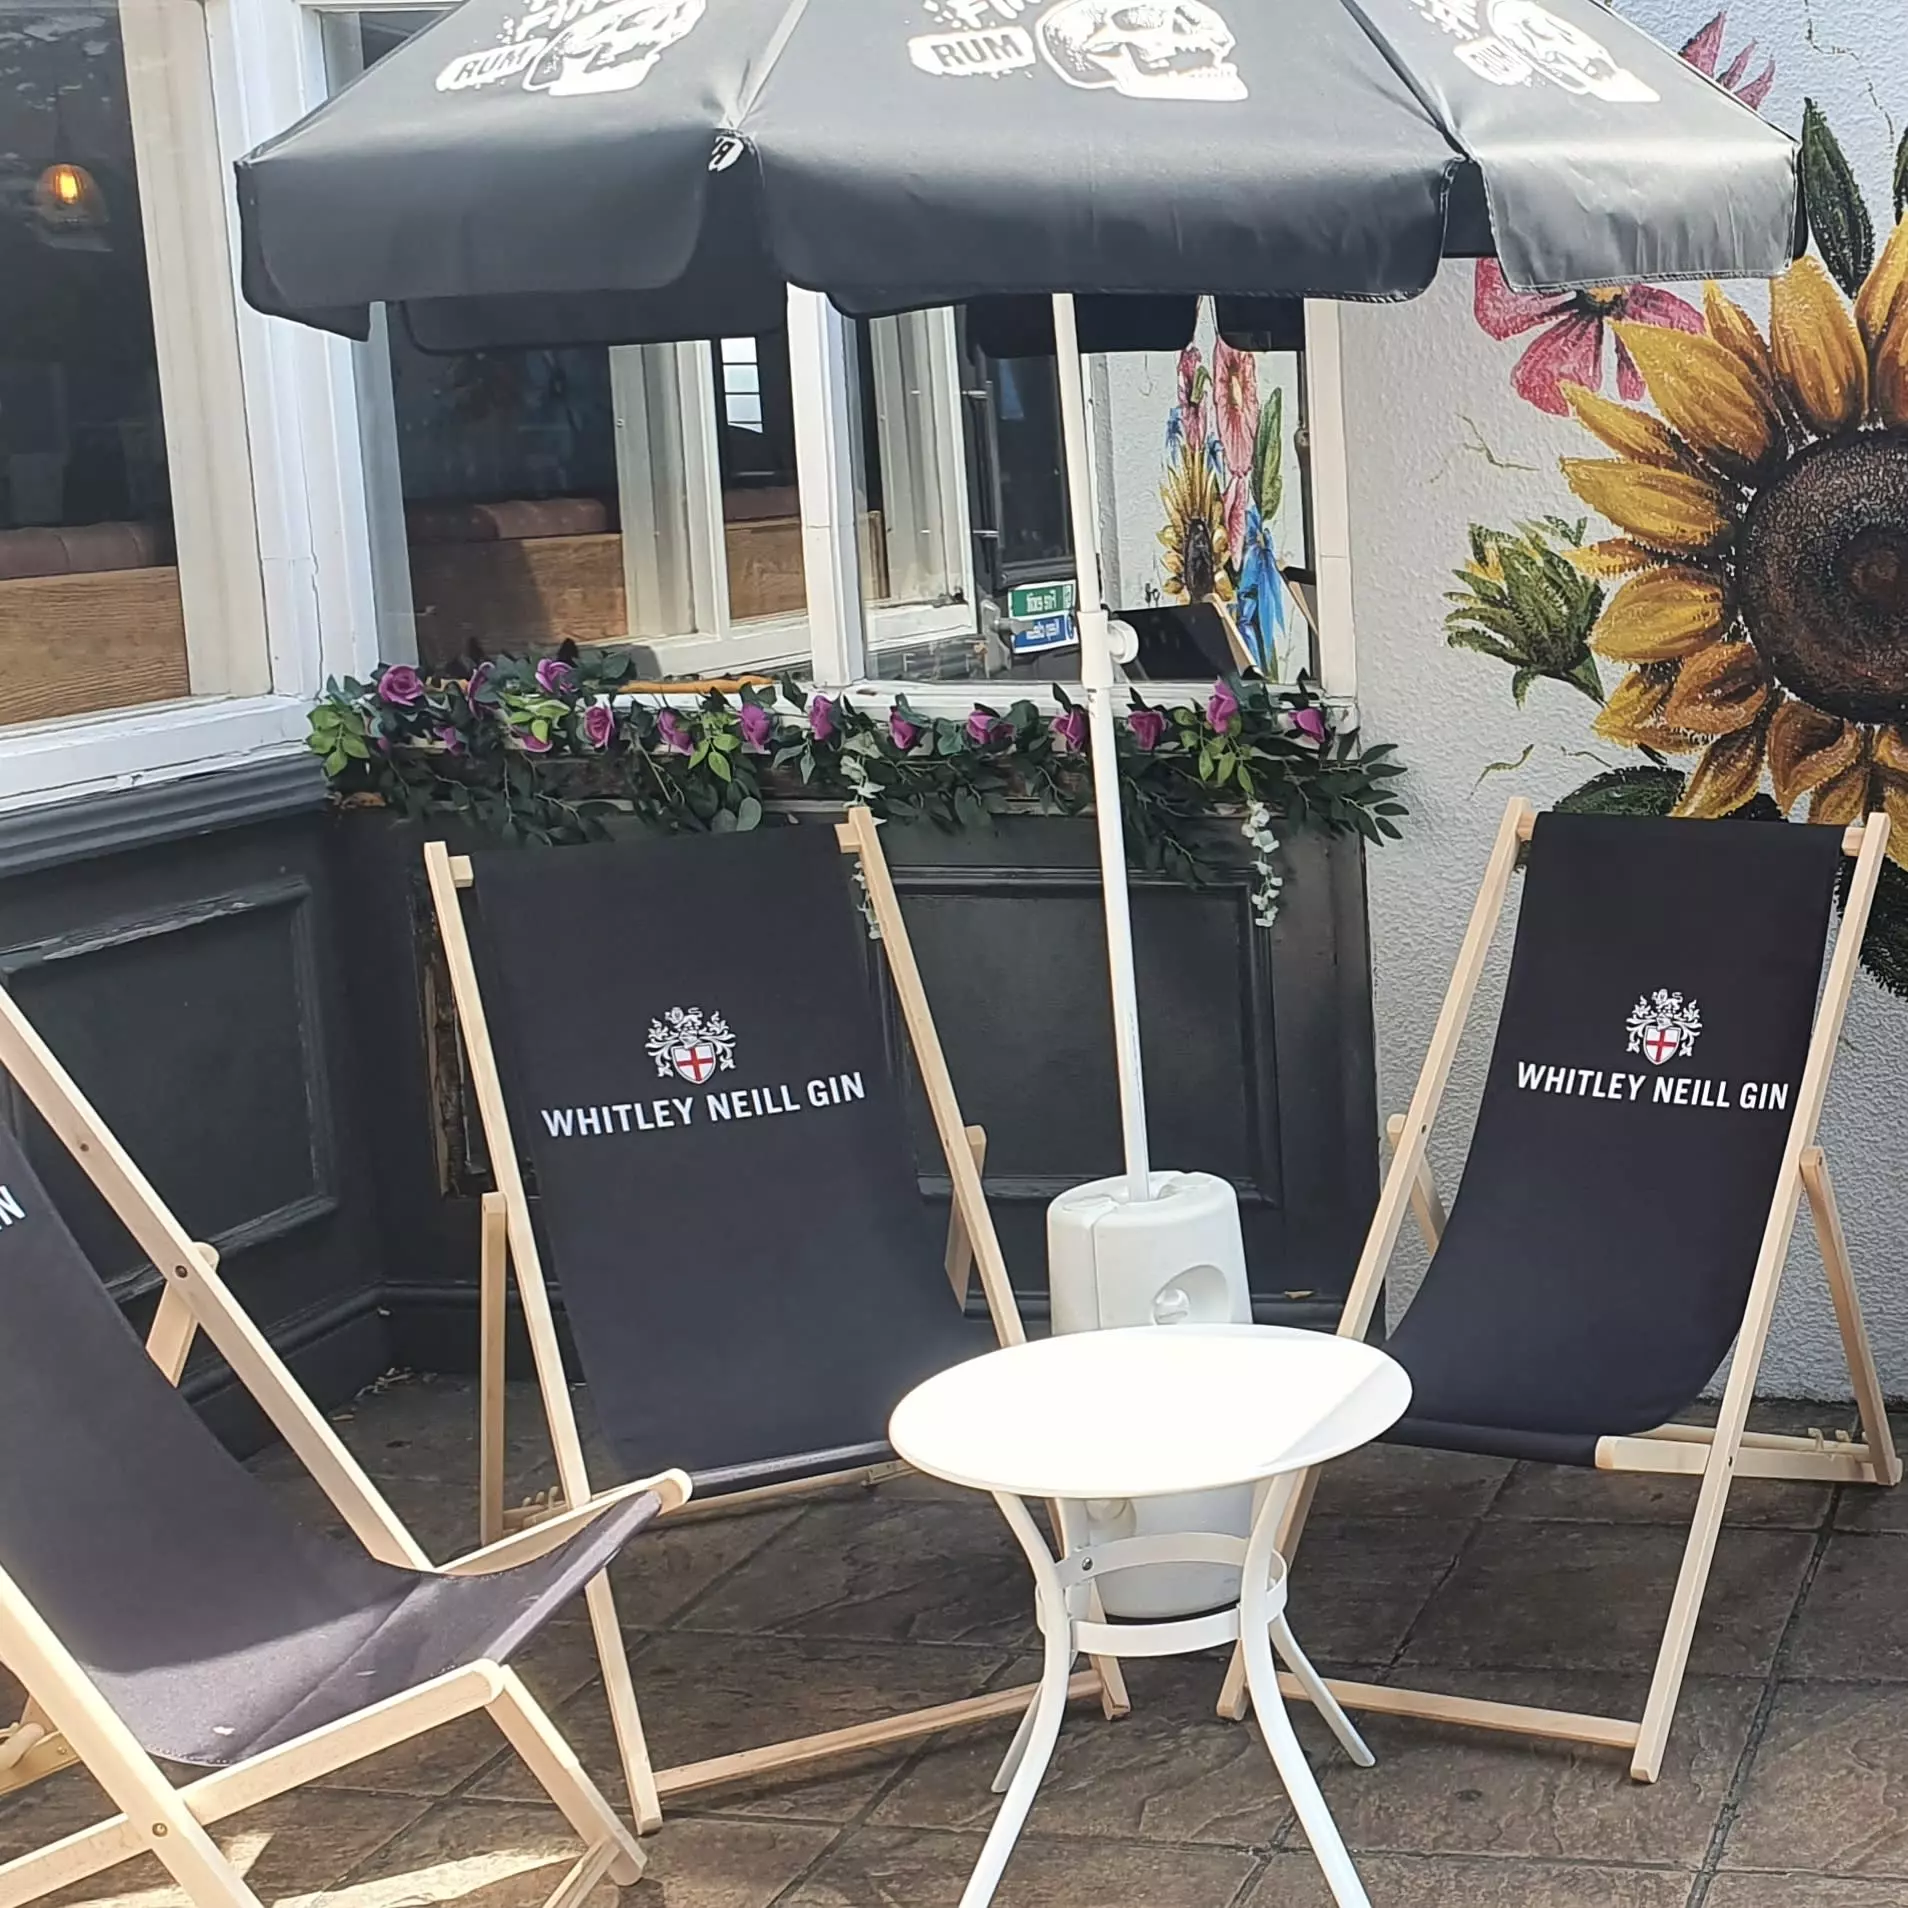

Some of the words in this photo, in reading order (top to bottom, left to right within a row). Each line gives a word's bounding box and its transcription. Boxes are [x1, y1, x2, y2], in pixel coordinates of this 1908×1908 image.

[453, 45, 532, 83] RUM
[931, 34, 1025, 68] RUM
[540, 1096, 694, 1137] WHITLEY
[706, 1084, 801, 1122] NEILL
[806, 1071, 865, 1107] GIN
[1518, 1061, 1647, 1101] WHITLEY
[1652, 1076, 1731, 1108] NEILL
[1739, 1082, 1789, 1110] GIN
